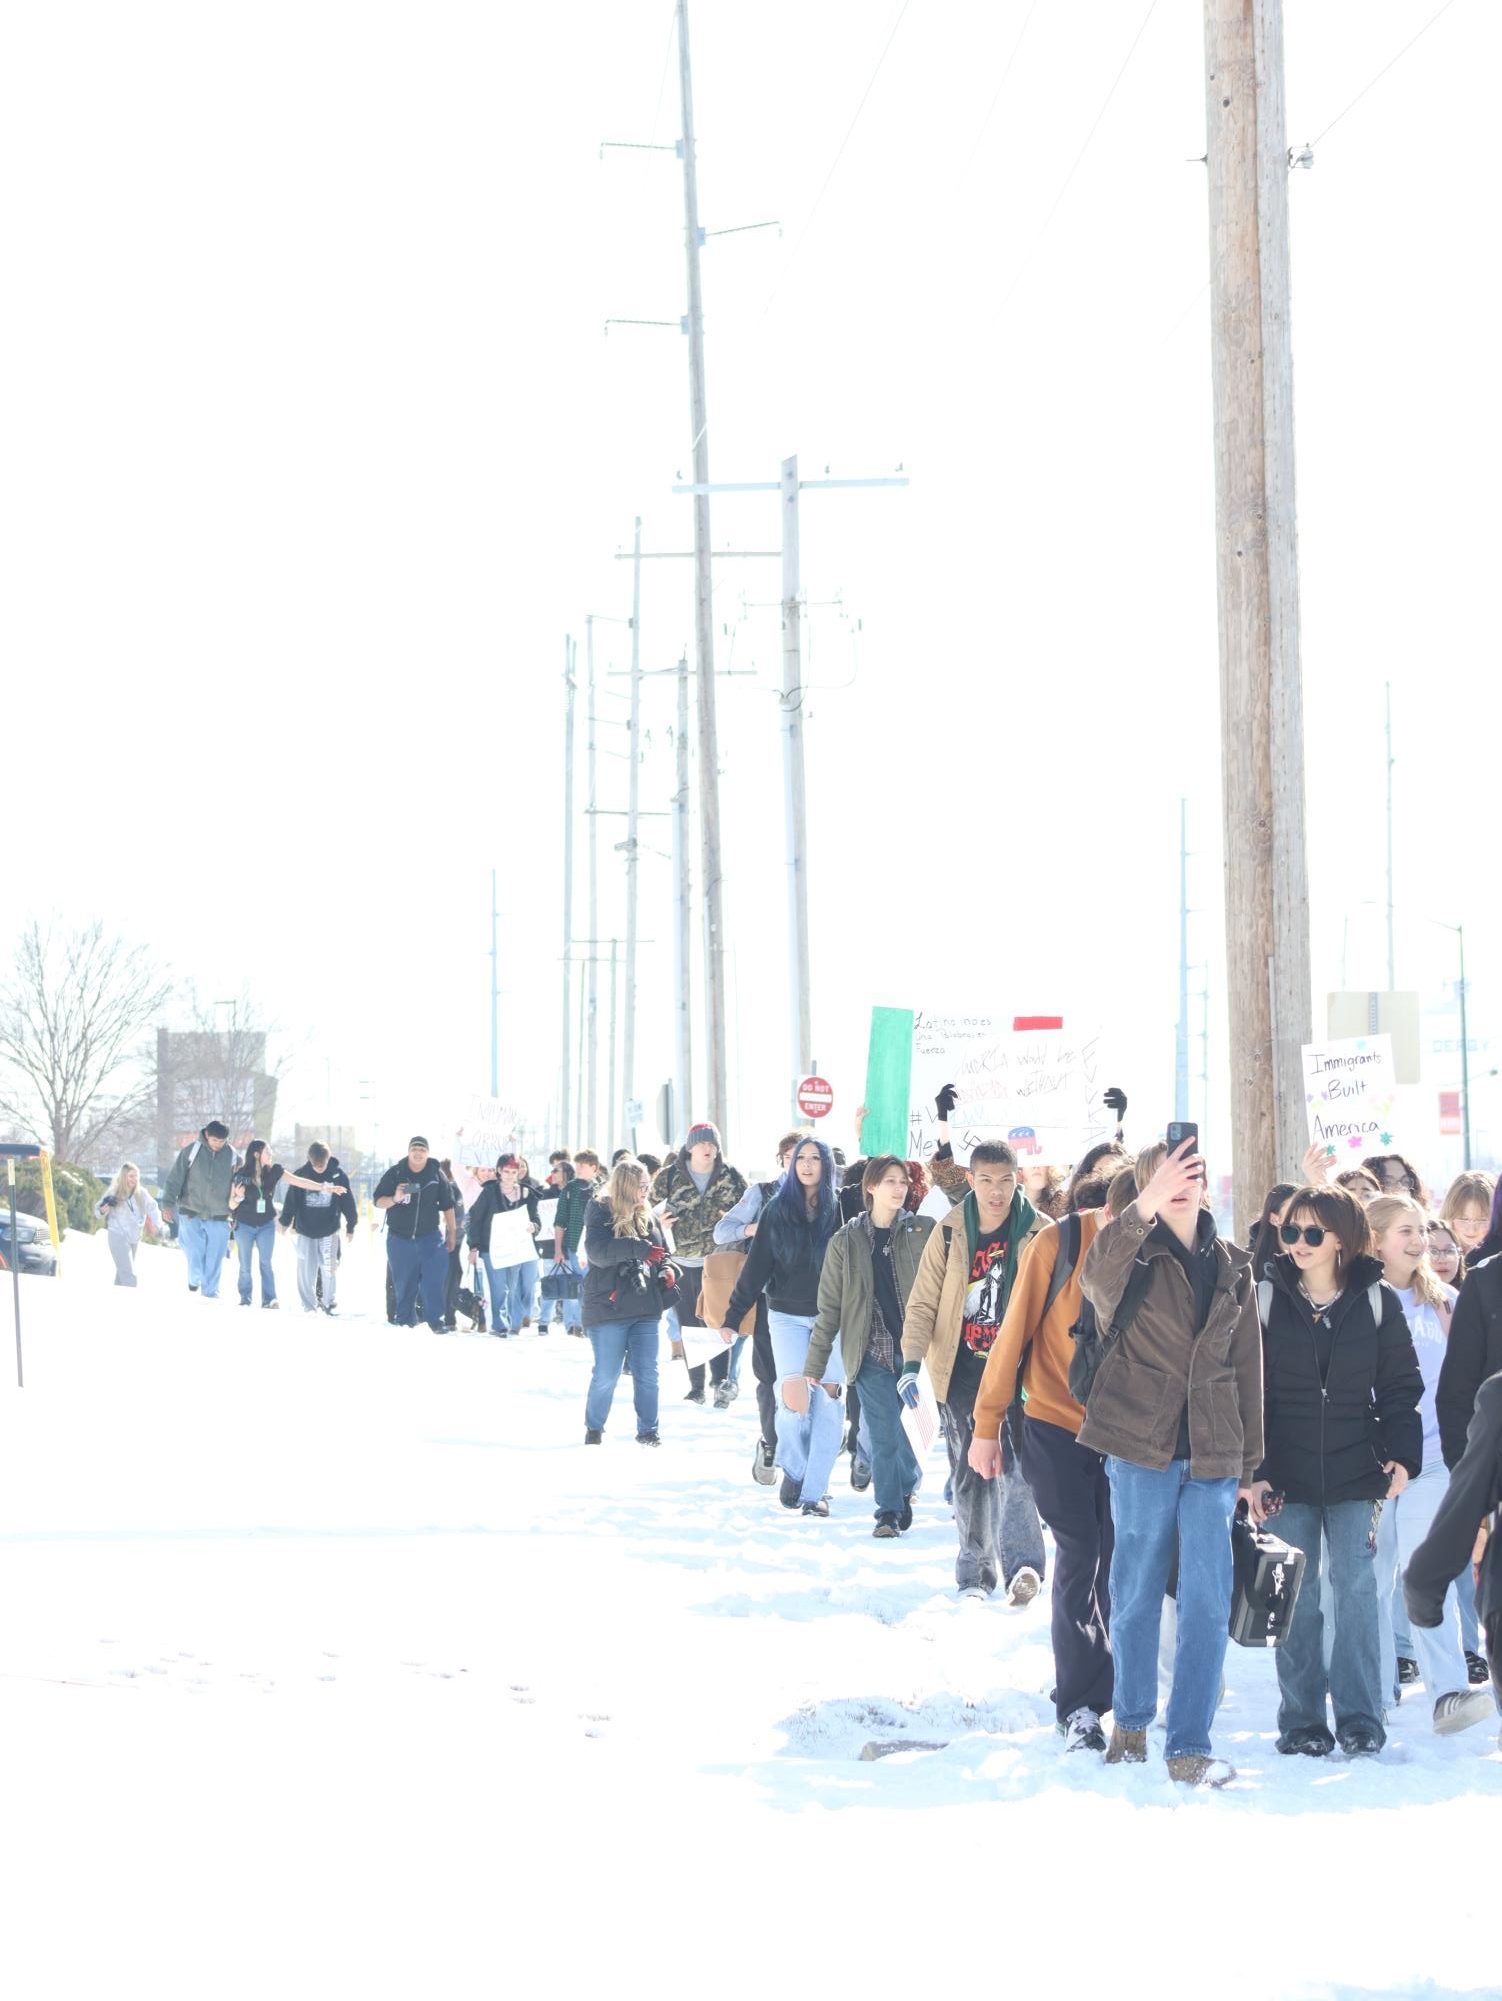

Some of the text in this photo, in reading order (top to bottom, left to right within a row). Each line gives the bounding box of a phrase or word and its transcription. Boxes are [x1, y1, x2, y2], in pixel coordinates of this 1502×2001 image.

[915, 1042, 946, 1055] Fuerza
[1307, 1051, 1381, 1075] Immigrants
[802, 1083, 829, 1093] DO NOT
[1328, 1079, 1368, 1100] Built
[804, 1102, 826, 1111] ENTER
[1312, 1114, 1380, 1140] America
